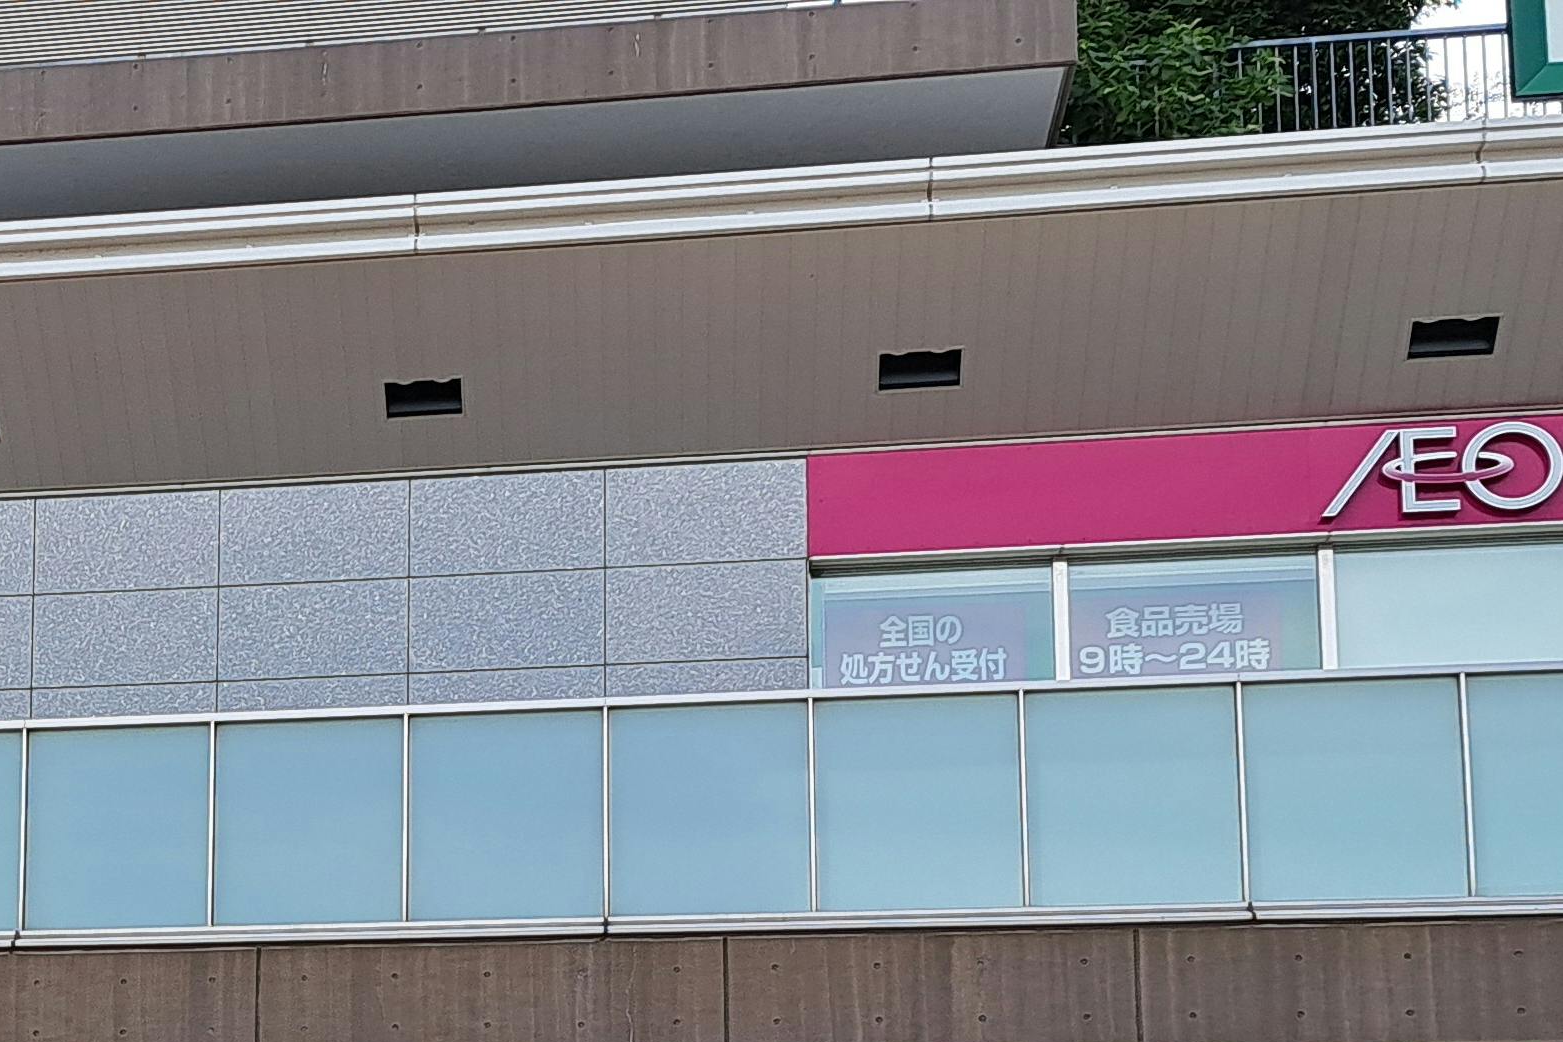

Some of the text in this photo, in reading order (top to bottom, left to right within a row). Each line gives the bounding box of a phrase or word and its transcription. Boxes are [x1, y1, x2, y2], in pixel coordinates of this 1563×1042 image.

[879, 615, 963, 648] 全国の
[1105, 603, 1244, 639] 食品売場
[840, 647, 1007, 685] 処方せん受付
